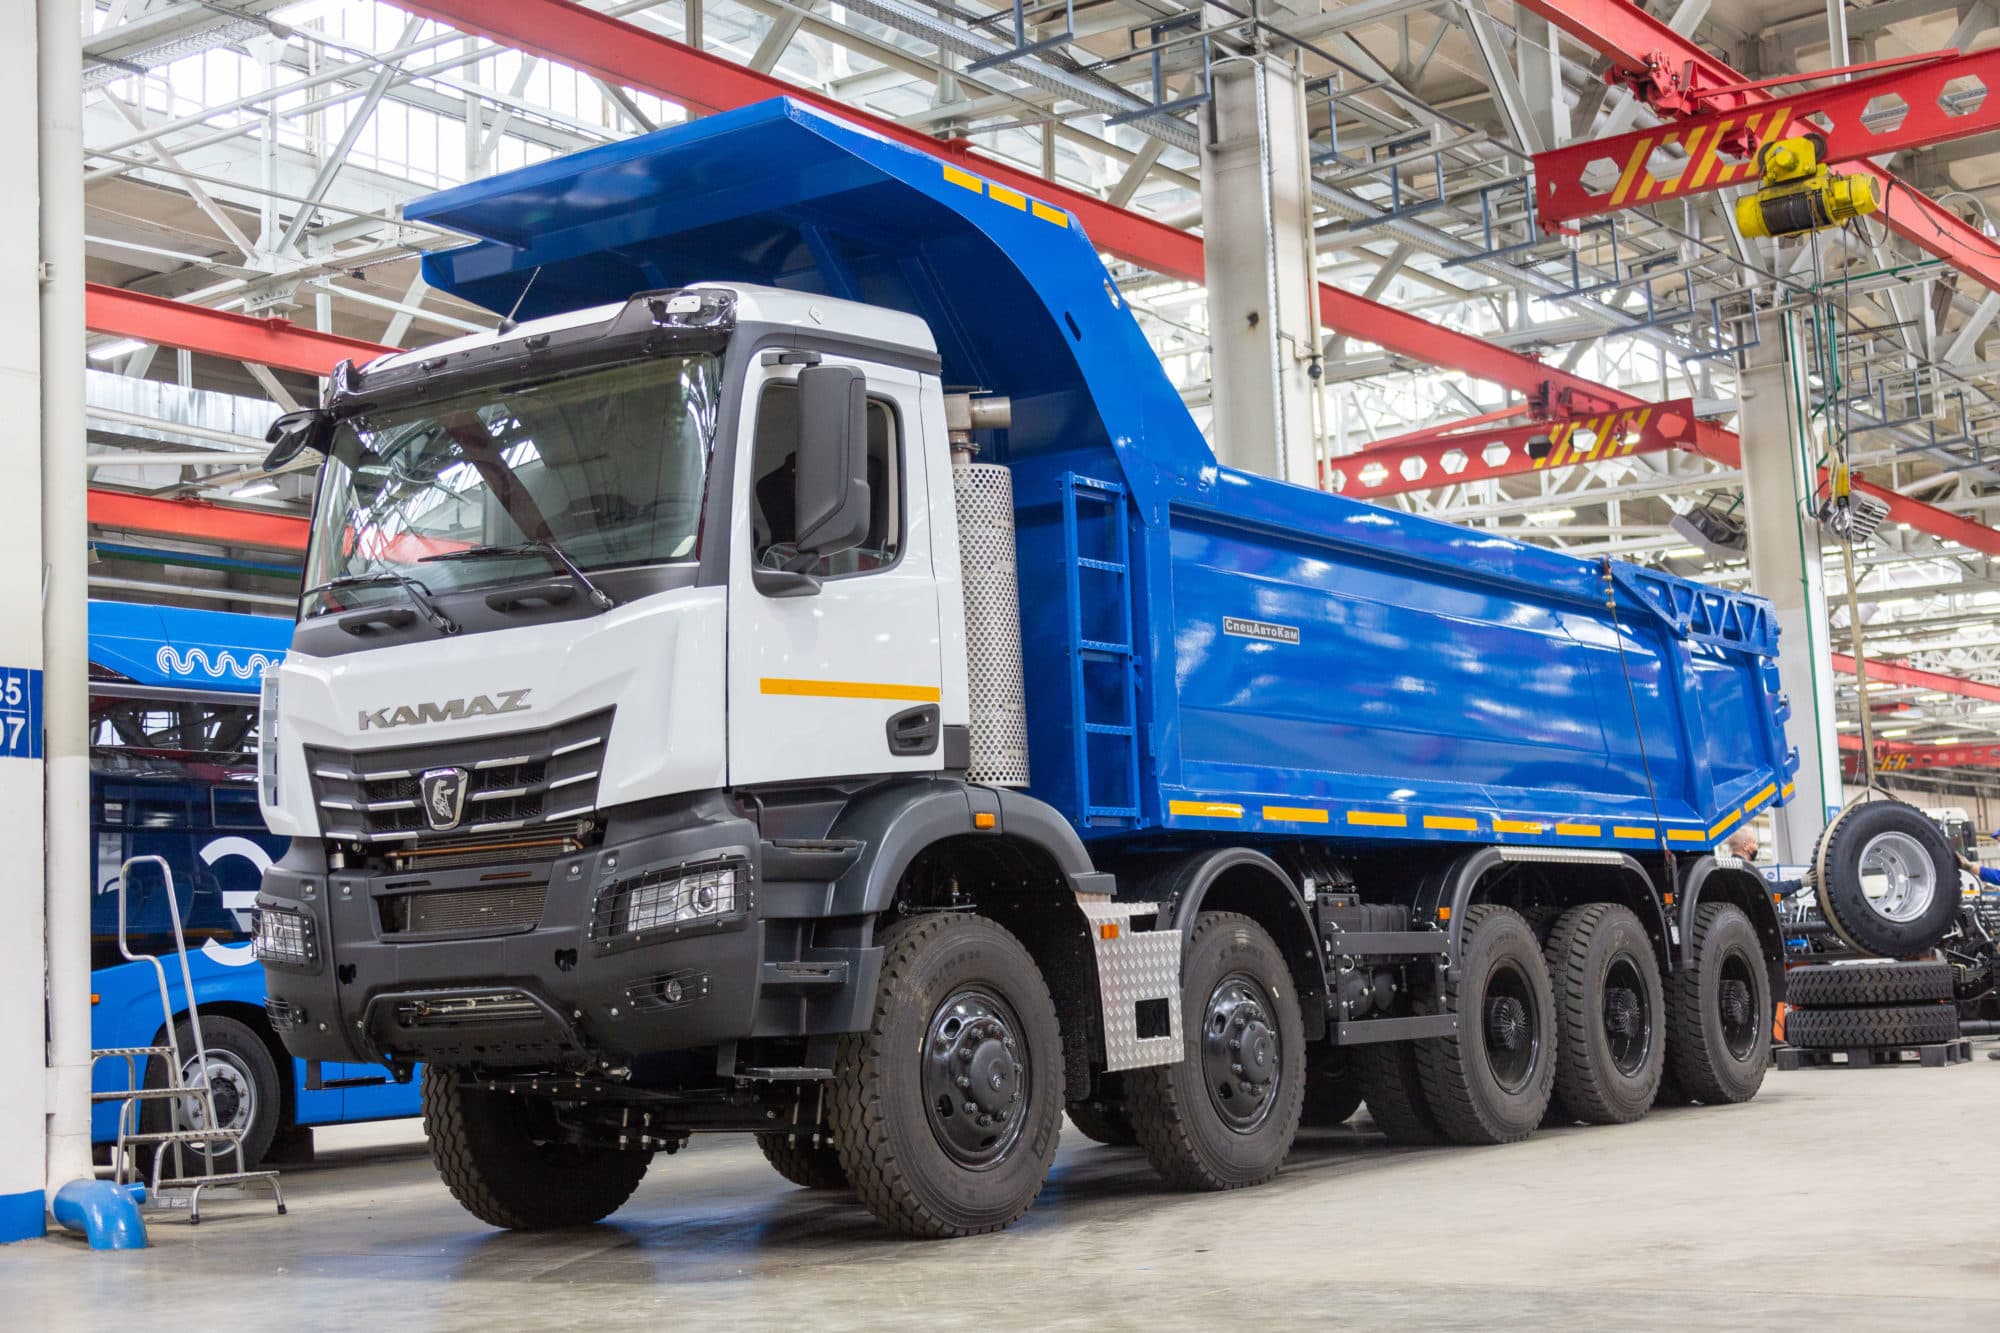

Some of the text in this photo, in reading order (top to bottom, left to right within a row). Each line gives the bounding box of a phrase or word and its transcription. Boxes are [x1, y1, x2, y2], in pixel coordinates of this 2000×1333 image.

[1225, 619, 1298, 640] СпецАвтоКам
[0, 676, 22, 706] 5
[358, 688, 533, 731] KAMAZ
[0, 716, 26, 749] 7
